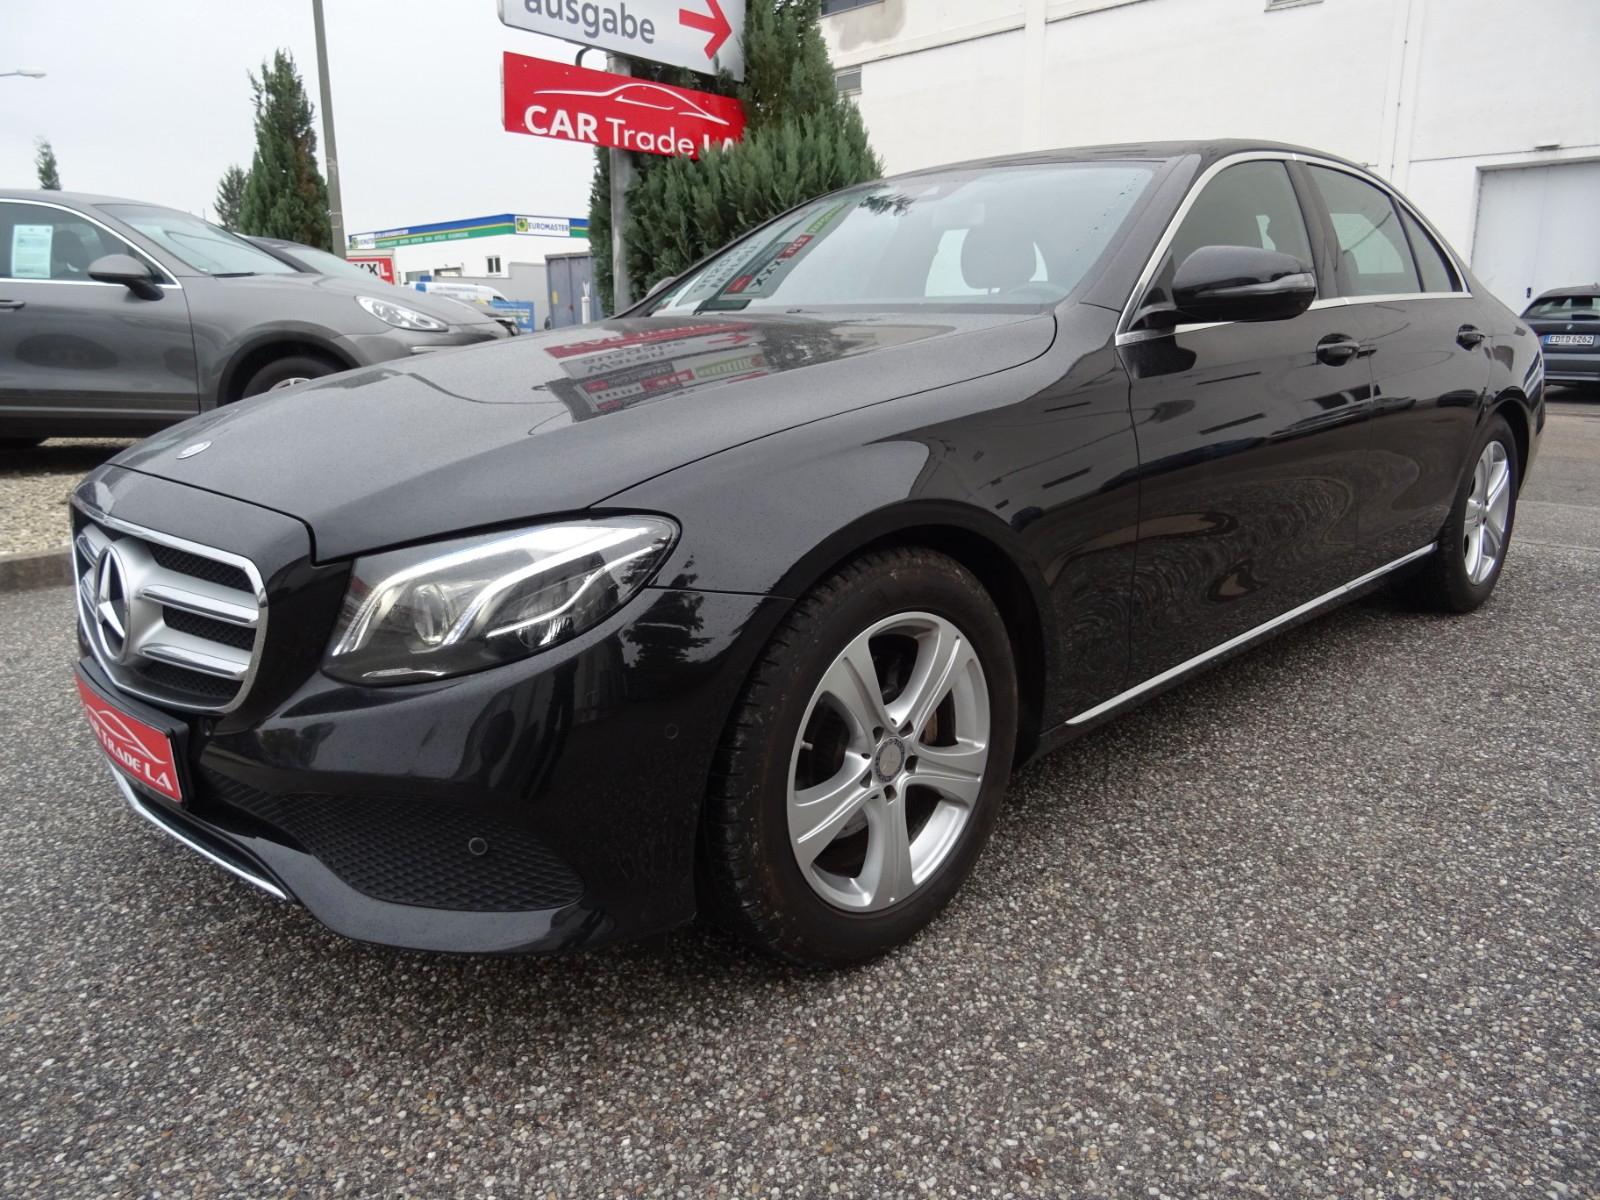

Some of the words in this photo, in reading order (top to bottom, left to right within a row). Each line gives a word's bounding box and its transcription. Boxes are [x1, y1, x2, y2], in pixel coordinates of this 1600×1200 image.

[525, 0, 655, 44] ausgabe
[524, 105, 599, 142] CAR
[605, 117, 695, 156] Trade
[528, 222, 569, 231] EUROMASTER
[101, 729, 141, 773] TRADE
[144, 762, 173, 792] LA
